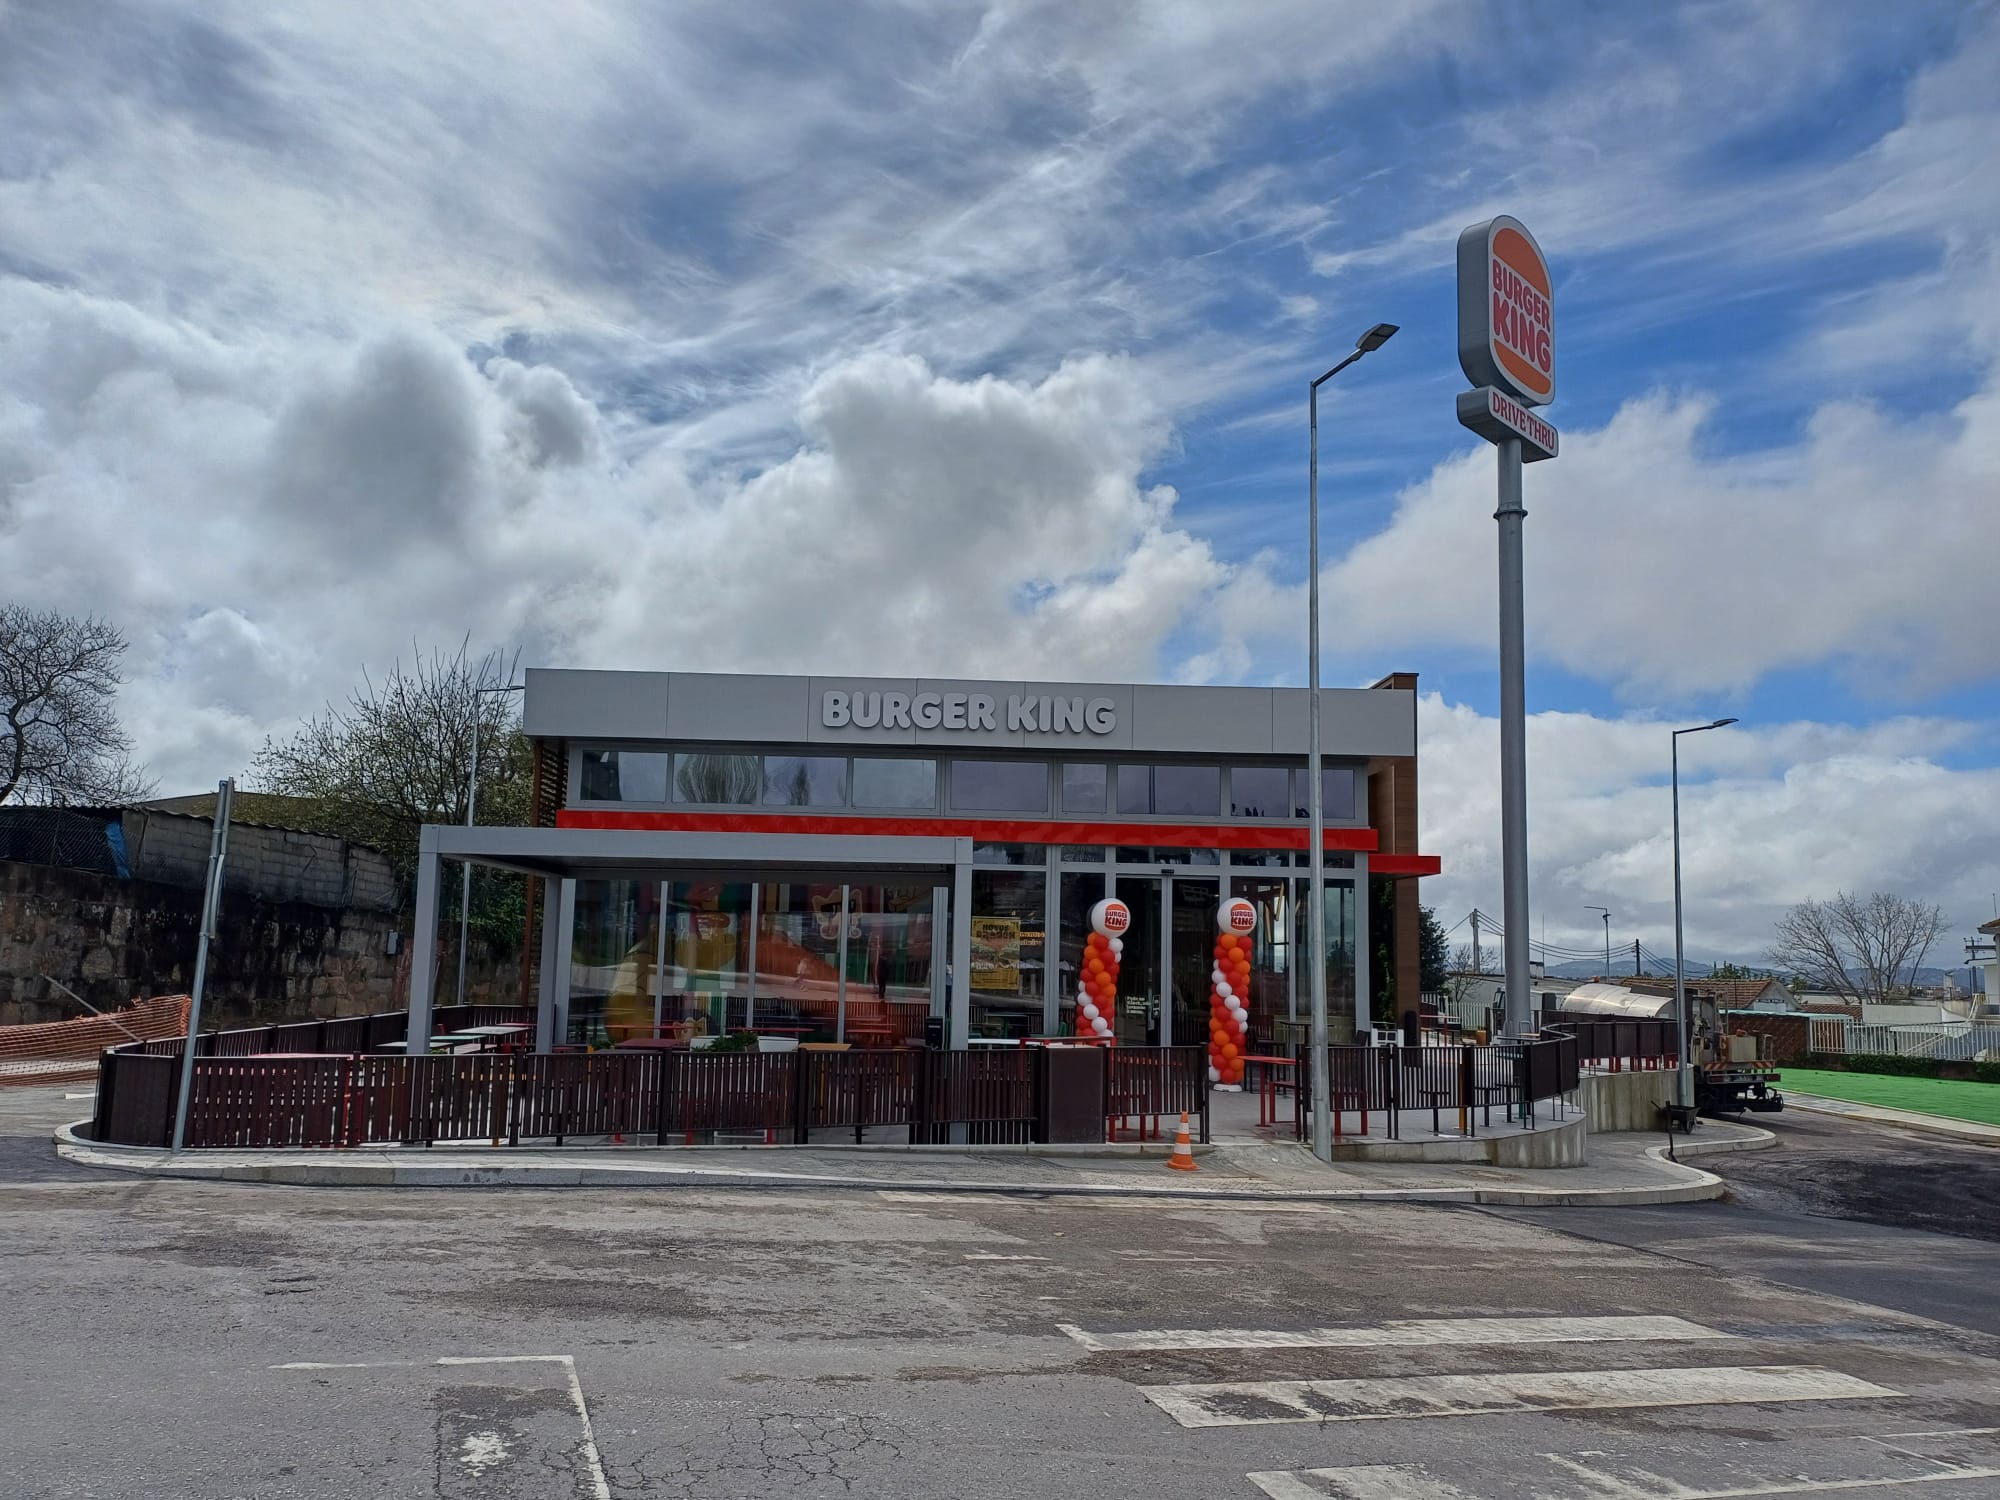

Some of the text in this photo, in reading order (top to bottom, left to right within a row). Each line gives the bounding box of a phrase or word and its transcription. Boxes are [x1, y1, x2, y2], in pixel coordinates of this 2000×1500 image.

[1493, 258, 1551, 333] BURGER
[1493, 291, 1551, 373] KING
[1492, 391, 1554, 450] DRIVE THRU
[822, 690, 1118, 734] BURGER KING
[1105, 916, 1128, 927] KING
[1230, 917, 1254, 926] KING
